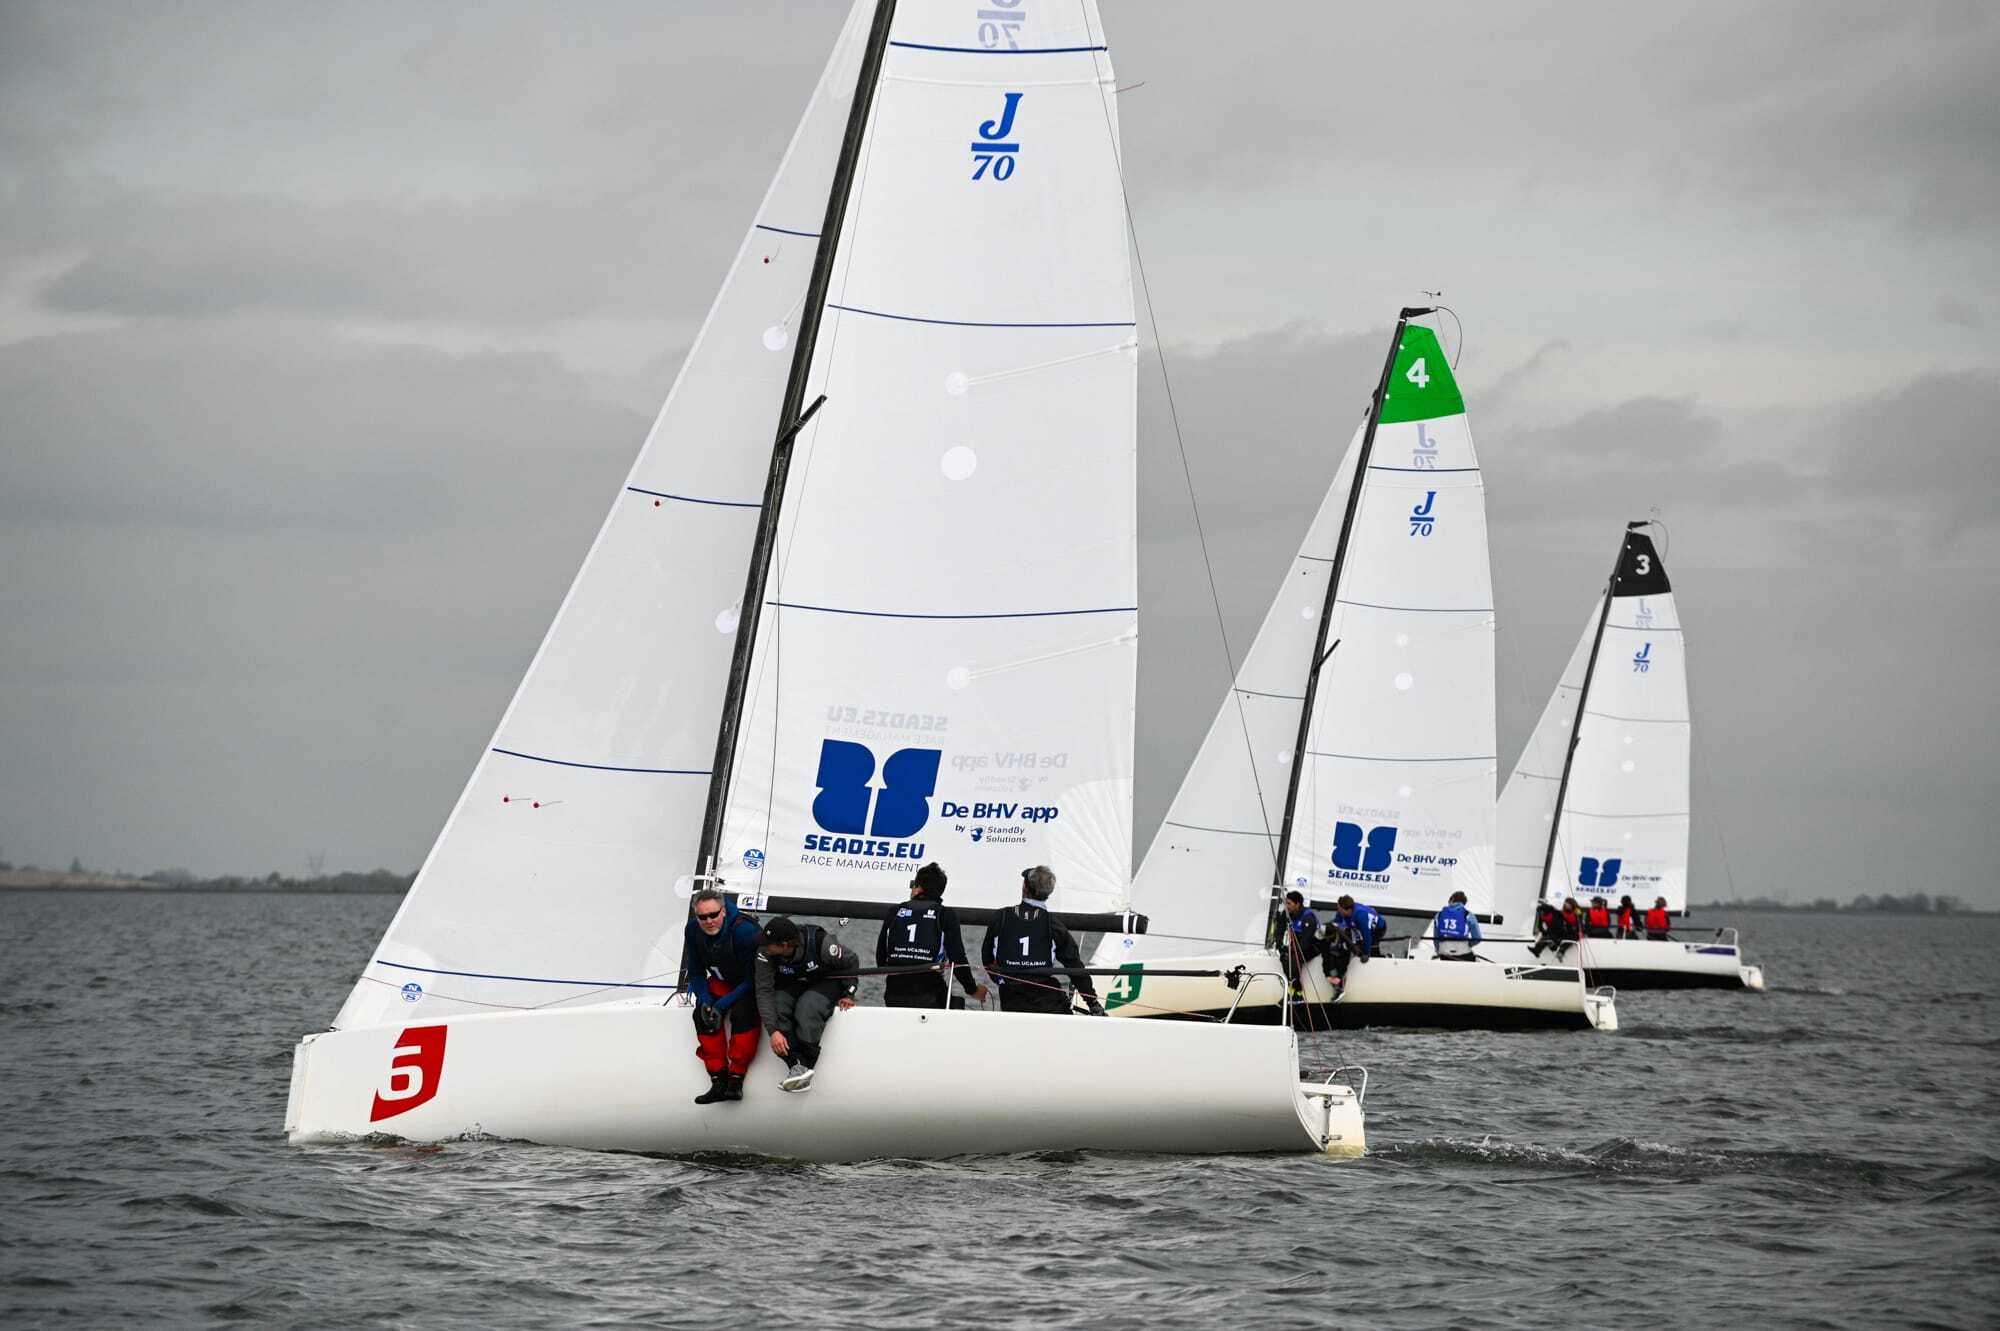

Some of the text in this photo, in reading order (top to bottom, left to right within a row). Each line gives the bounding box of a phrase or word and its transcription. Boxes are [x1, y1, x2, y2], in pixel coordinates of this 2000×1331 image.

[978, 92, 1024, 140] J
[972, 155, 1015, 181] 70
[1406, 357, 1430, 388] 4
[1414, 491, 1436, 515] J
[1410, 523, 1432, 536] 70
[1635, 554, 1650, 575] 3
[1635, 642, 1651, 659] J
[1633, 663, 1648, 673] 70
[941, 802, 1059, 823] De BHV app
[955, 824, 966, 833] by
[804, 834, 925, 859] SEADIS.EU
[801, 855, 921, 873] RACE MANAGEMENT
[1397, 854, 1458, 867] De BHV app
[1328, 869, 1390, 883] SEADIS.EU
[907, 923, 917, 943] 1
[1443, 918, 1457, 930] 13
[1019, 935, 1030, 956] 1
[1111, 974, 1132, 998] 4
